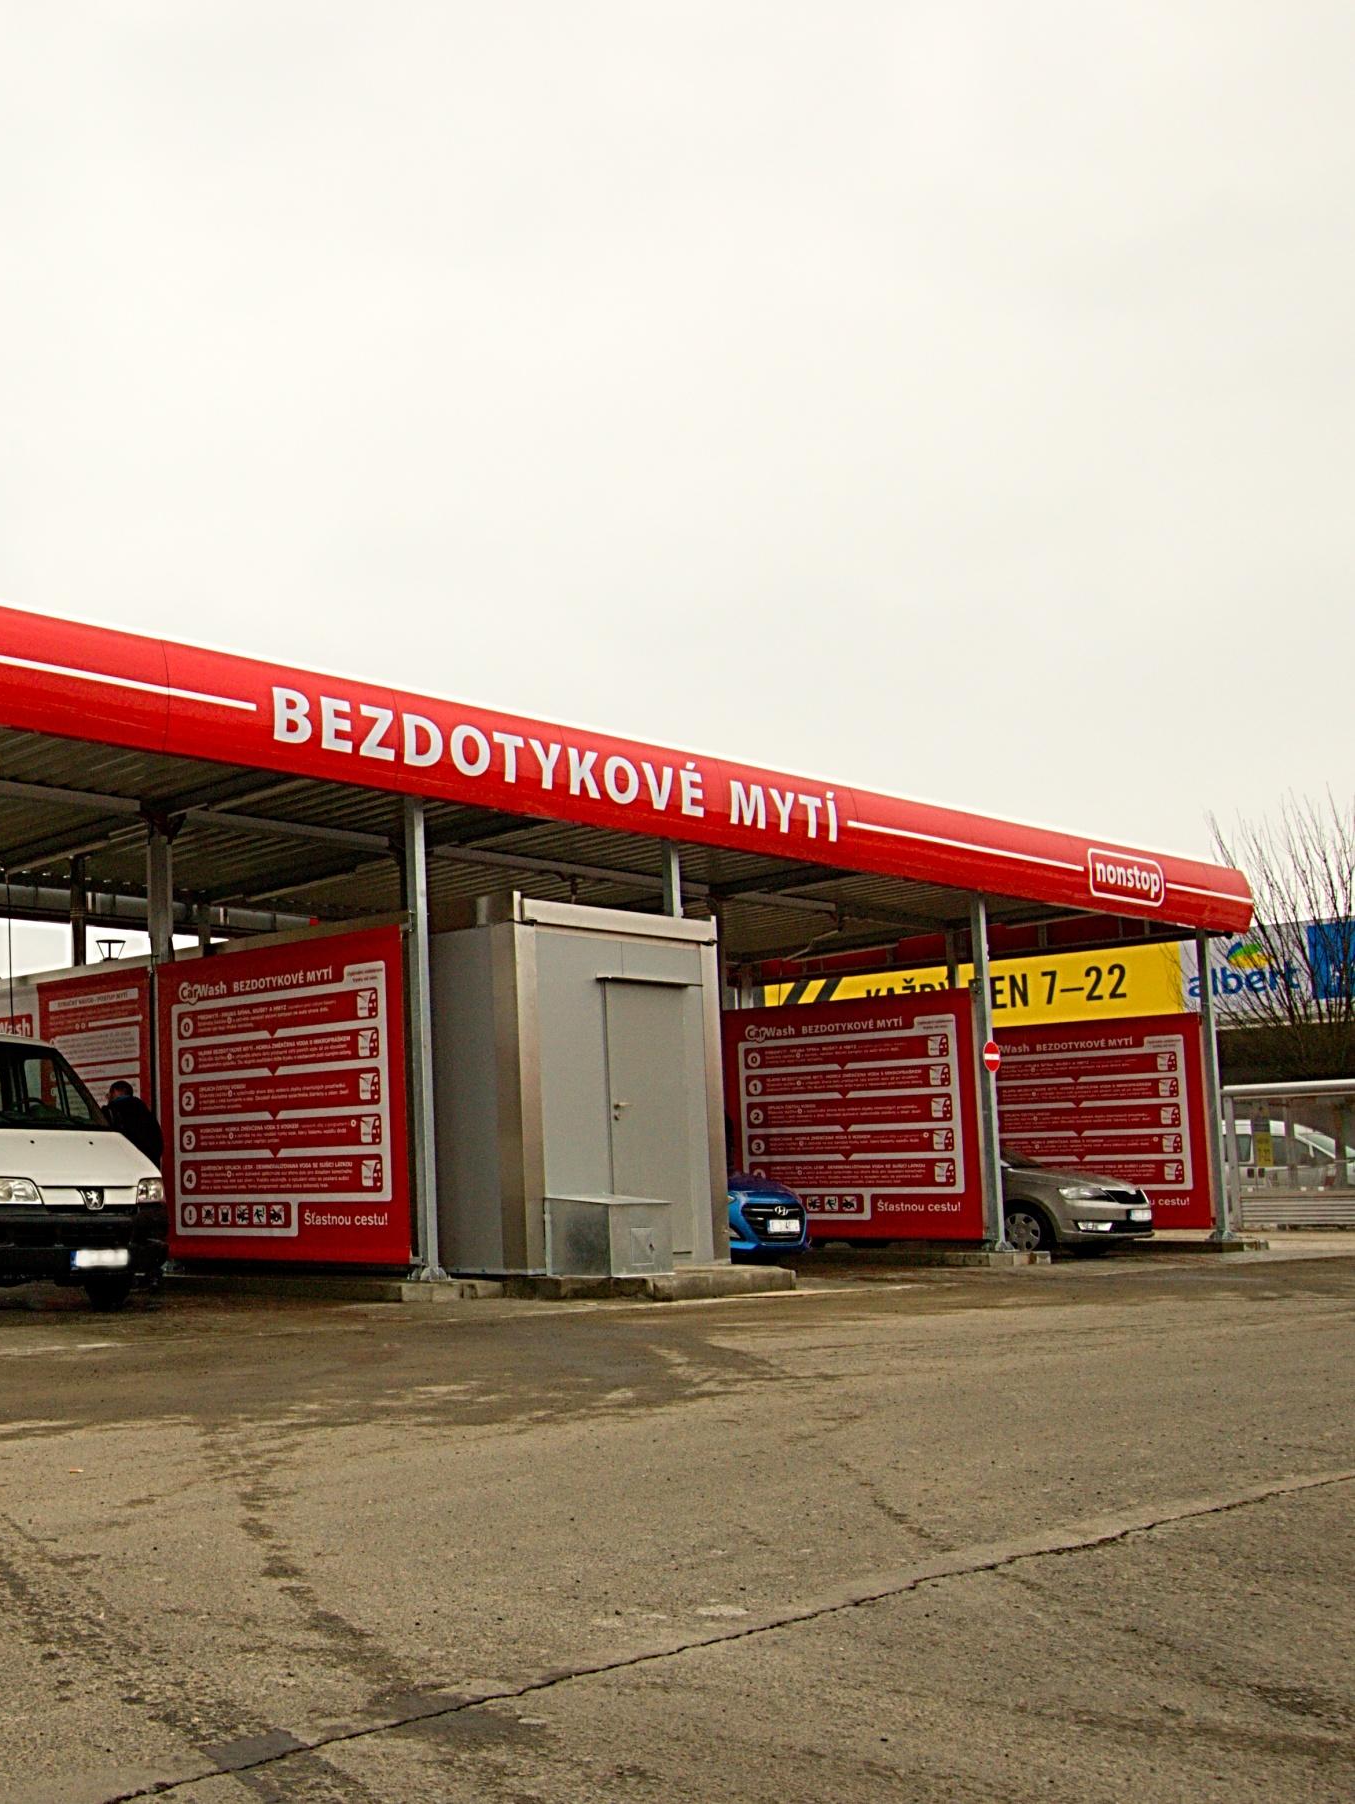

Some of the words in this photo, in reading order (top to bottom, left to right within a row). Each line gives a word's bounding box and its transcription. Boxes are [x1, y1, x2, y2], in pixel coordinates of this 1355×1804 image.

[271, 686, 704, 818] BEZDOTYKOVÉ
[729, 779, 839, 842] MYTÍ
[1095, 862, 1160, 899] nonstop
[179, 981, 227, 1004] CarWash
[233, 970, 304, 993] BEZDOTYKOVÉ
[306, 966, 332, 983] MYTÍ
[991, 973, 1029, 1009] EN
[802, 1018, 874, 1034] BEZDOTYKOVÉ
[877, 1016, 903, 1028] MYTÍ
[1036, 1038, 1105, 1052] BEZDOTYKOVÉ
[1108, 1036, 1133, 1047] MYTÍ
[877, 1199, 925, 1212] Šťastnou
[927, 1201, 961, 1212] cestu!
[1158, 1197, 1190, 1206] cestu!
[304, 1209, 351, 1226] Šťastnou
[354, 1212, 389, 1226] cestu!
